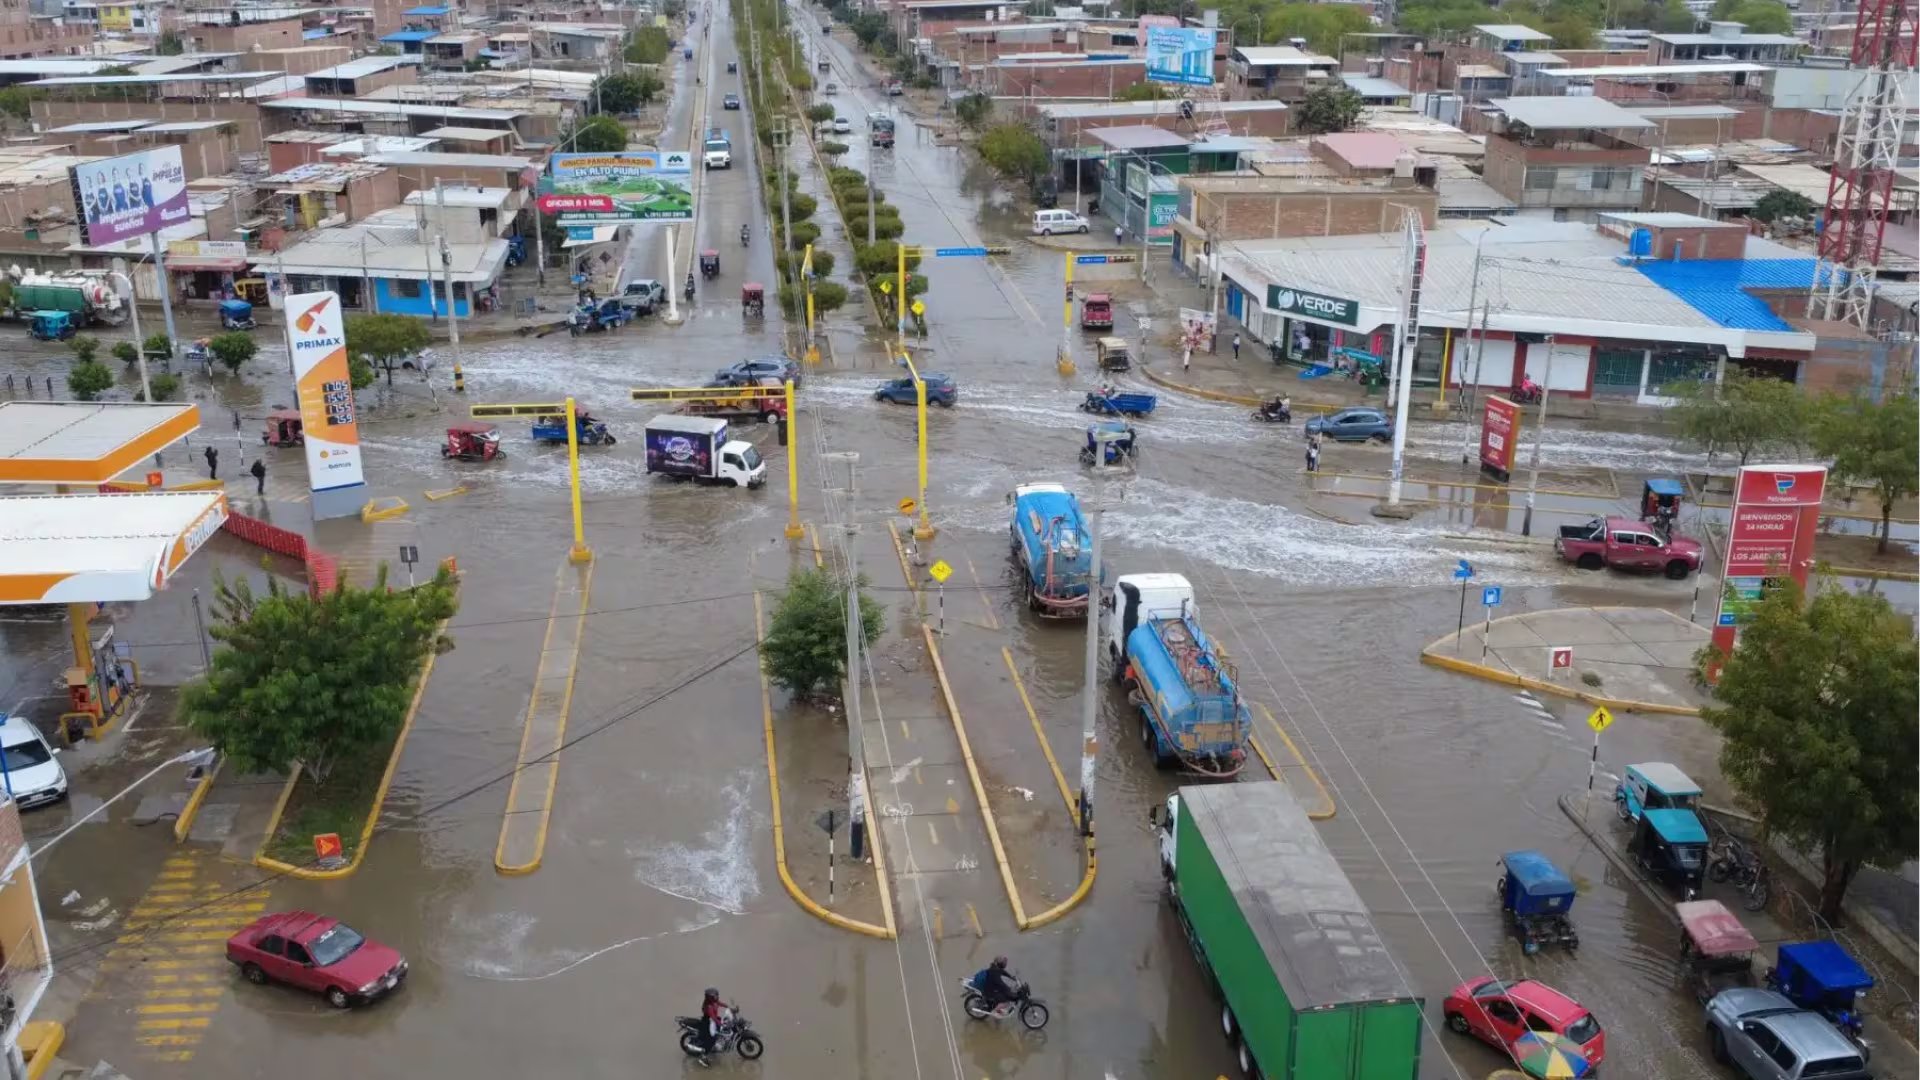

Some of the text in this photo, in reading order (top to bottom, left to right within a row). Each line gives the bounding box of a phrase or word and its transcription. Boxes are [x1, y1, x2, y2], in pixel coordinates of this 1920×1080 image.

[589, 167, 611, 176] ALTO
[1295, 293, 1347, 316] VERDE
[296, 337, 341, 350] PRIMAX
[1740, 513, 1793, 521] BIENVENIDOS
[185, 503, 224, 552] PRIMAX
[1756, 523, 1784, 531] HORAS
[1732, 552, 1748, 560] LOS
